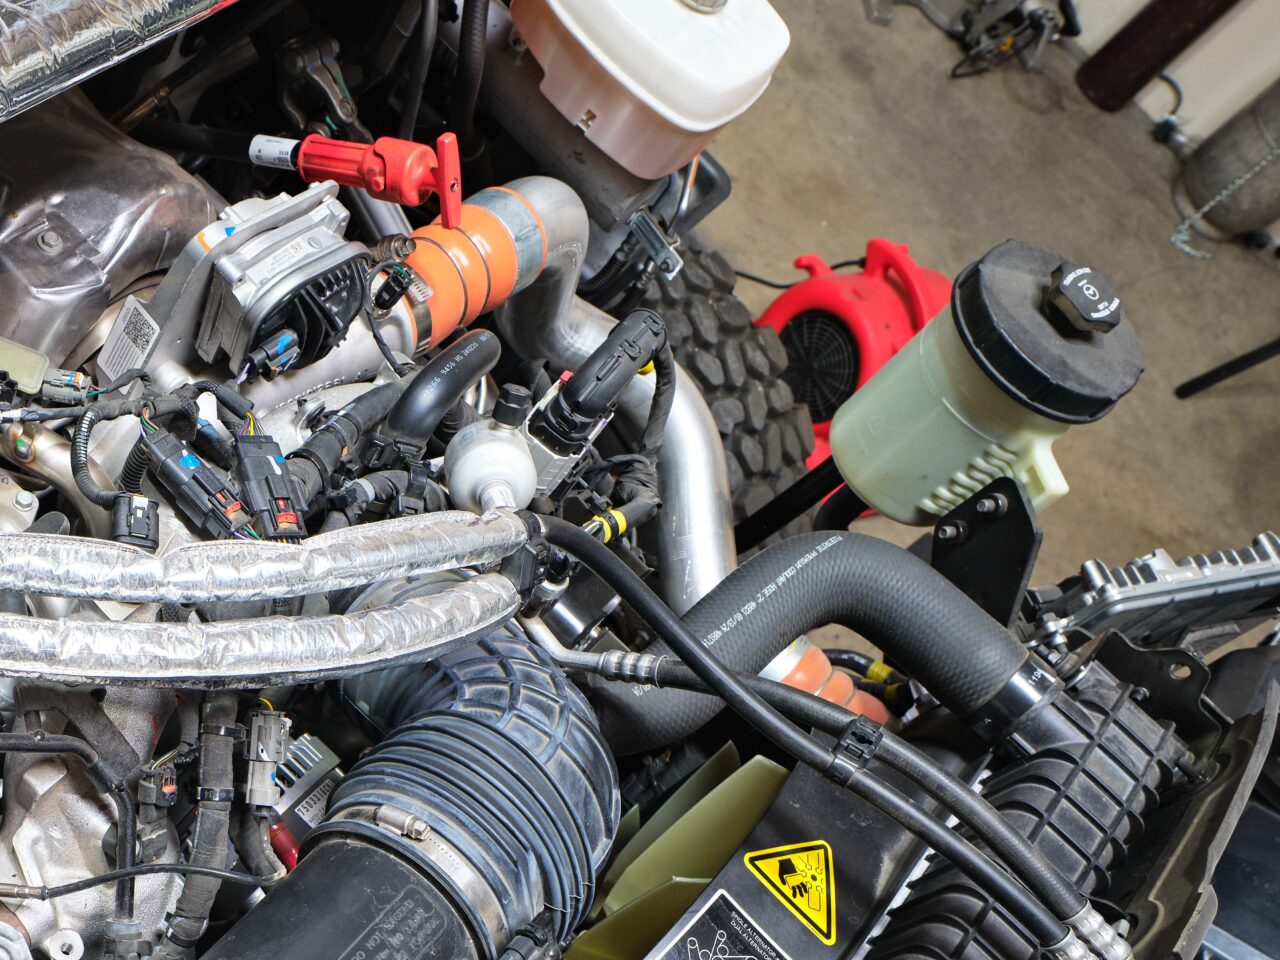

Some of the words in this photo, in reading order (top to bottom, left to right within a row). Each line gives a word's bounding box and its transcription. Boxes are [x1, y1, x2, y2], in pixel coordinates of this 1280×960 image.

[440, 361, 456, 375] 9456
[815, 535, 843, 553] FLEETRITE
[796, 550, 818, 570] PREMIUM
[775, 566, 797, 586] COOLANT
[762, 582, 777, 597] HOSE
[730, 920, 745, 936] DUAL
[730, 911, 748, 929] SINGLE
[747, 927, 777, 959] ALTERNATOR
[365, 931, 384, 950] NOT
